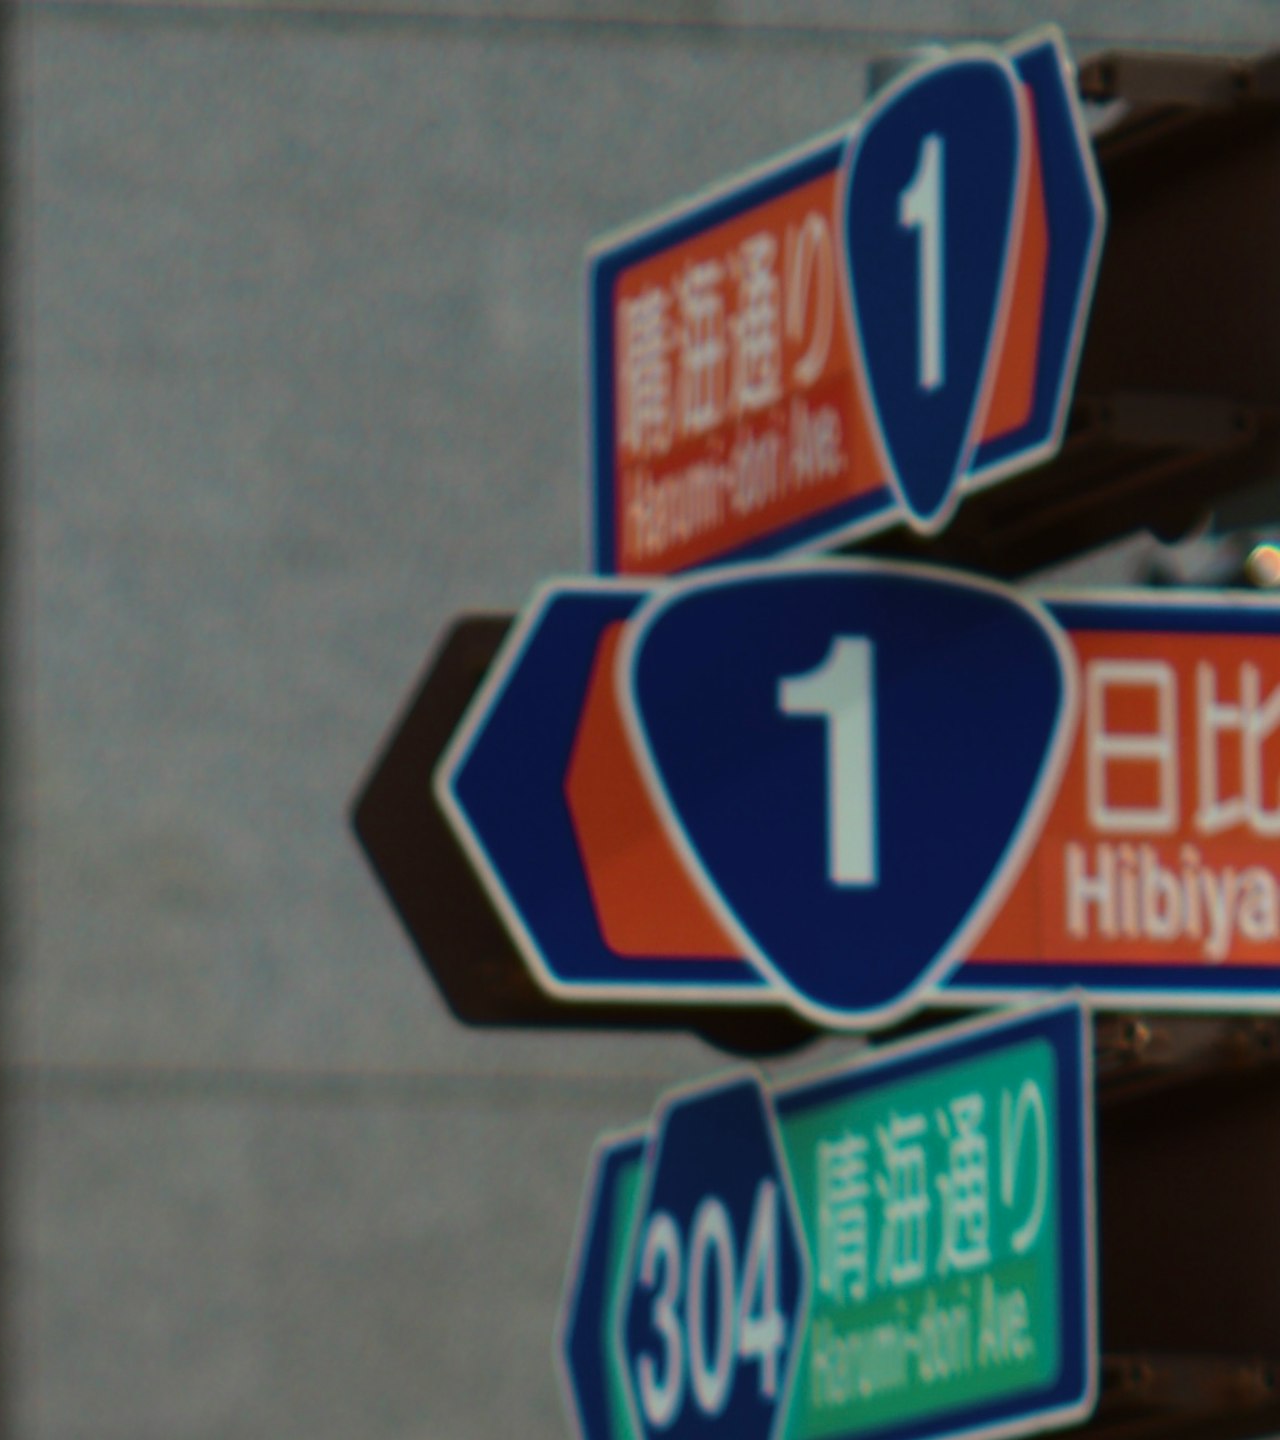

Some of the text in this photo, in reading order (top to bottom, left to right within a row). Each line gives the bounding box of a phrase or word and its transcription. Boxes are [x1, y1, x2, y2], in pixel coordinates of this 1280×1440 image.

[900, 134, 944, 391] 1
[778, 635, 878, 888] 1
[637, 1178, 786, 1428] 304
[817, 1078, 1050, 1303] 晴海通り
